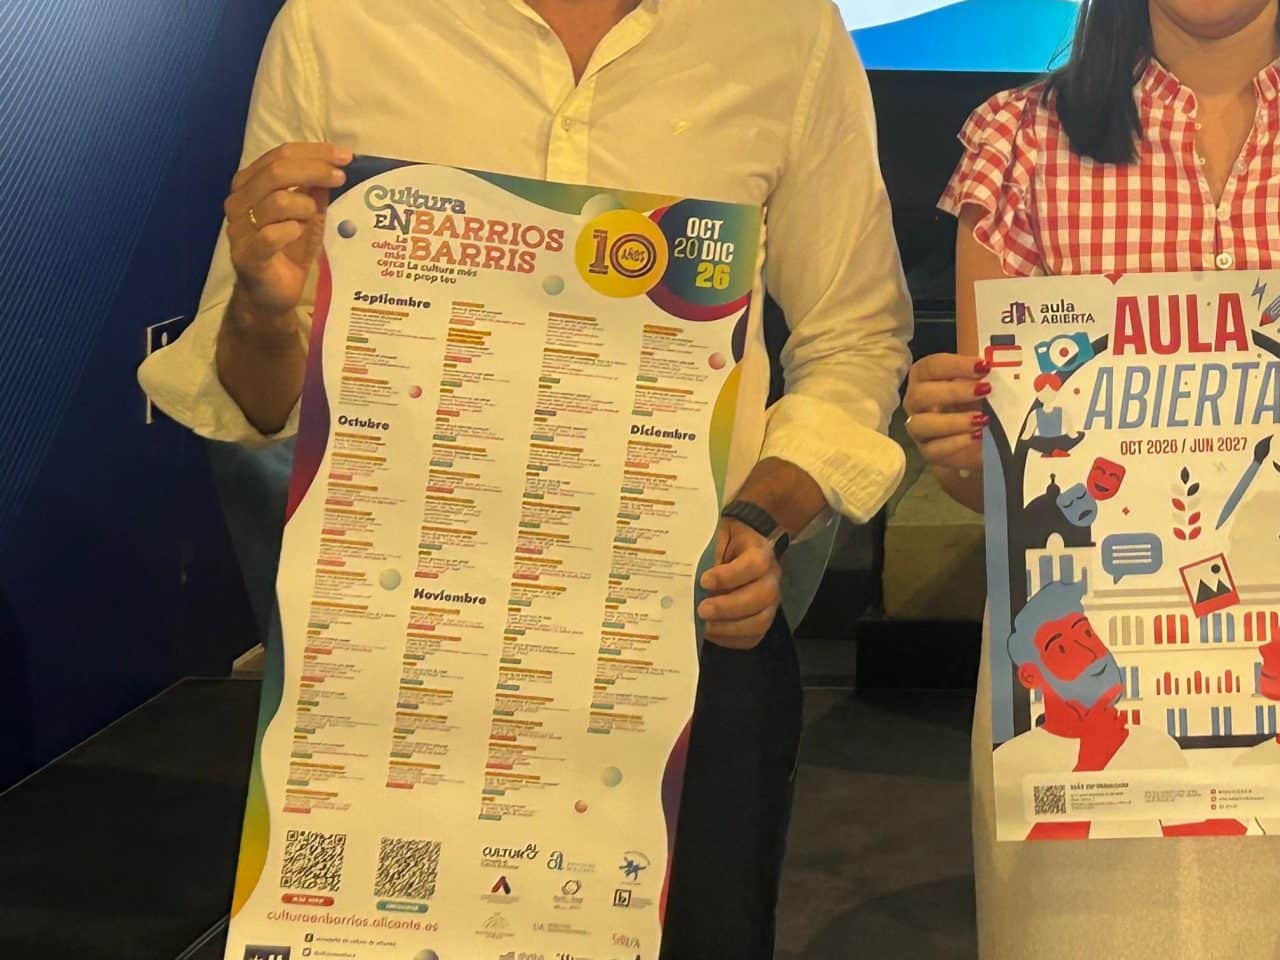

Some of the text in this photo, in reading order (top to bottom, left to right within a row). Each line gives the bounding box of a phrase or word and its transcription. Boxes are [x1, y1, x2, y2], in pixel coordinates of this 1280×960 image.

[364, 184, 466, 215] Cultura
[373, 204, 565, 252] EN BARRIOS
[686, 217, 723, 239] OCT
[408, 236, 537, 274] BARRIS
[589, 229, 657, 279] 10
[674, 237, 735, 263] 20 DIC
[407, 261, 418, 270] La
[420, 263, 455, 275] cultura
[695, 262, 731, 290] 26
[413, 272, 439, 284] prop
[353, 291, 431, 309] Septiembre
[1040, 299, 1075, 313] aula
[1040, 314, 1095, 325] ABIERTA
[1112, 292, 1249, 356] AULA
[337, 415, 390, 431] Octubre
[630, 424, 697, 442] Diciembre
[1120, 440, 1144, 455] OCT
[1181, 438, 1187, 453] /
[1189, 437, 1214, 453] JUN
[1217, 436, 1248, 452] 2027
[413, 587, 487, 606] Noviembre
